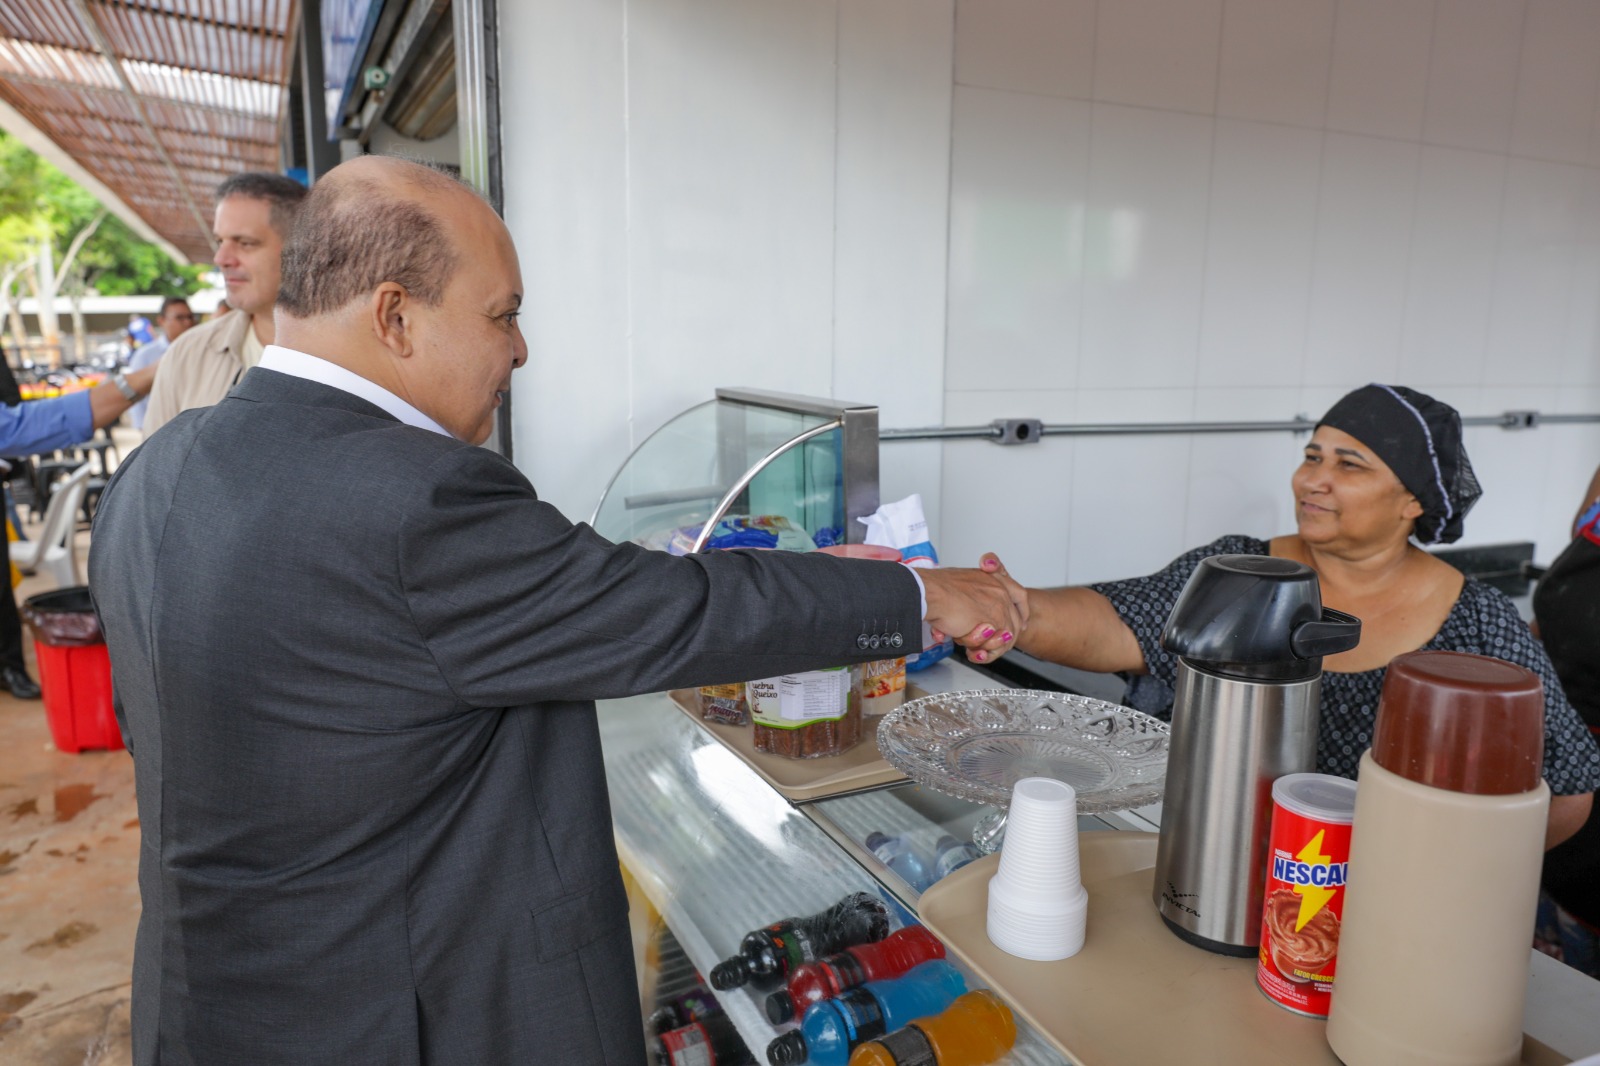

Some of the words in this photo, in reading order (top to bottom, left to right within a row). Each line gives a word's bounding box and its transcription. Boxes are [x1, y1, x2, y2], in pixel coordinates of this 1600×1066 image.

[751, 681, 774, 690] uebra
[1162, 892, 1198, 917] INVICTA
[1311, 973, 1335, 982] CRESCE
